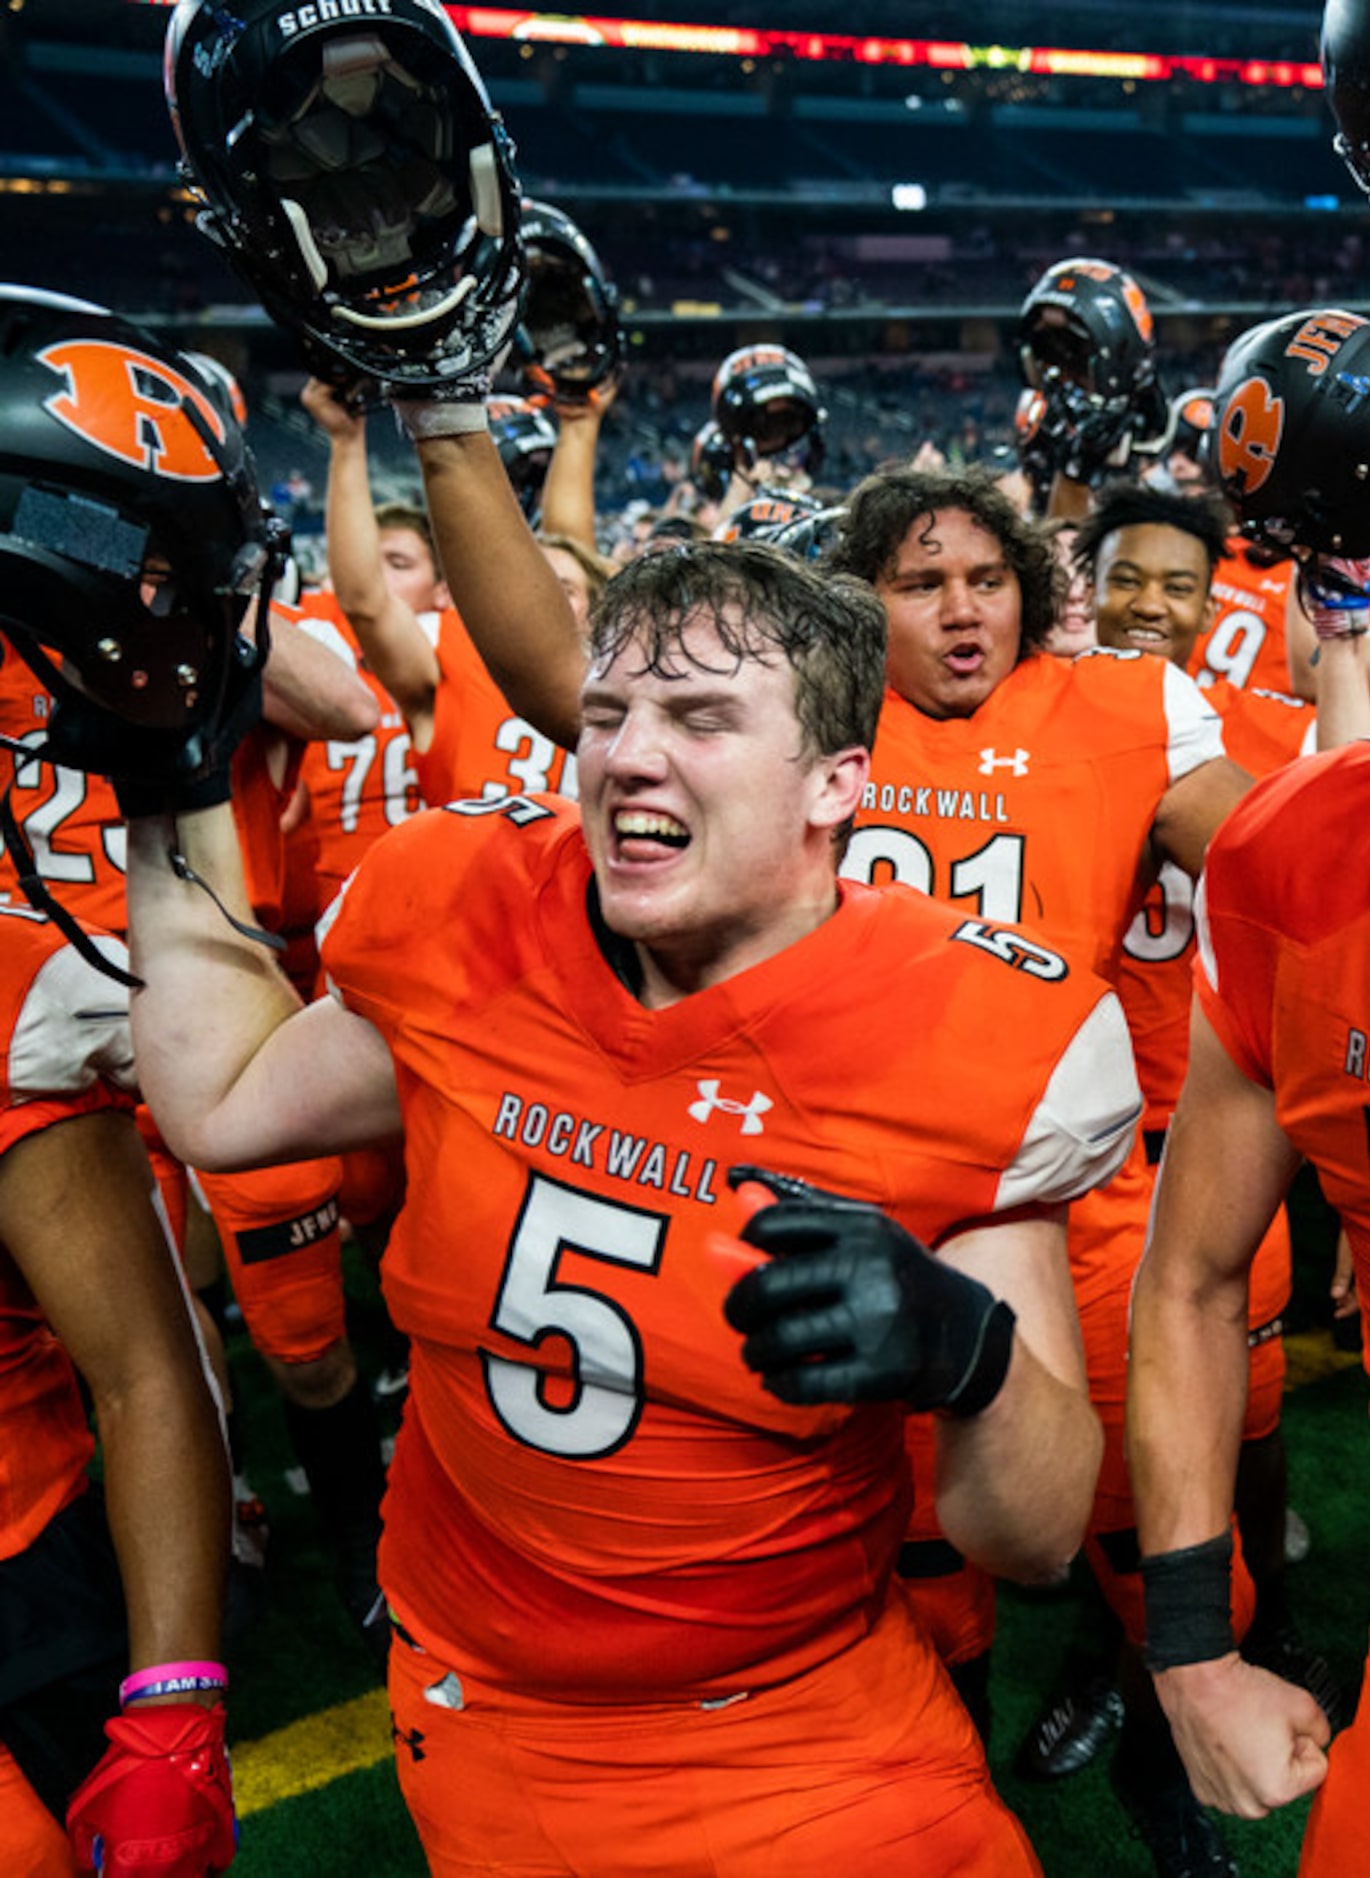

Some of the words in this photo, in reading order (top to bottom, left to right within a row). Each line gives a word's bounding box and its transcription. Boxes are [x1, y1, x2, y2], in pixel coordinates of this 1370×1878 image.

[277, 0, 392, 37] schutt
[33, 338, 227, 484] R
[1219, 376, 1285, 496] R
[326, 733, 428, 834] 76
[861, 781, 1009, 822] ROCKWALL
[948, 919, 1070, 984] 5
[492, 1092, 718, 1204] ROCKWALL
[477, 1169, 669, 1460] 5
[165, 1677, 198, 1693] AM
